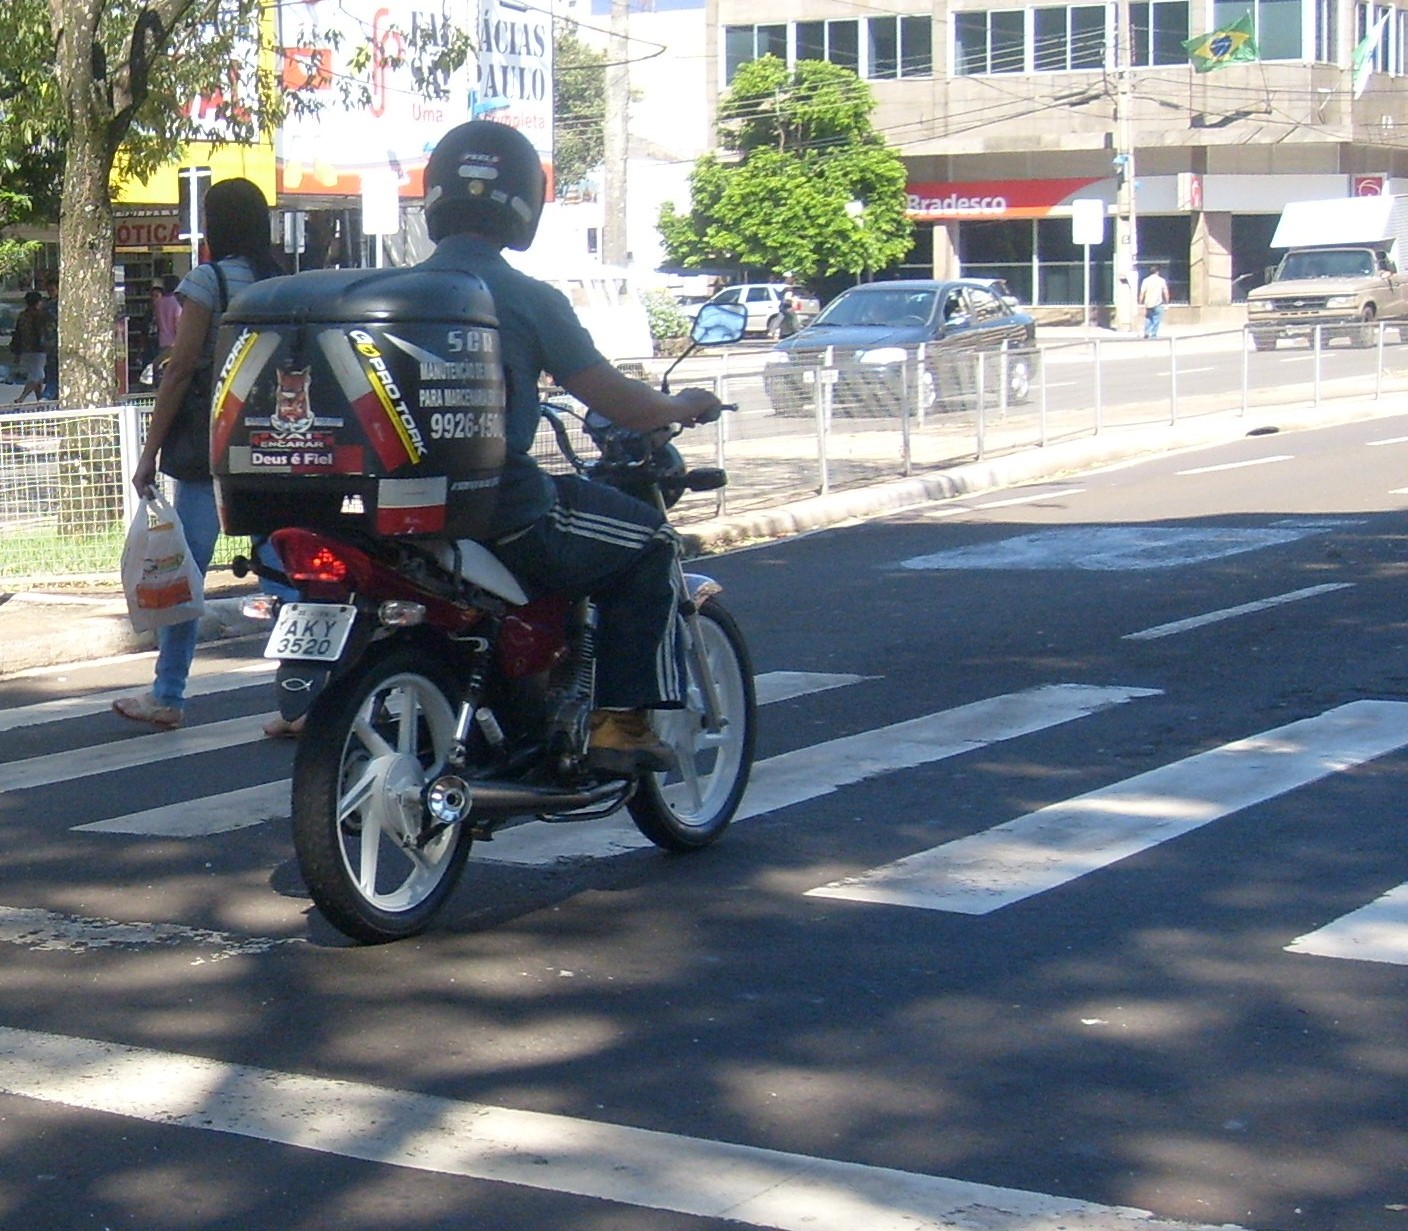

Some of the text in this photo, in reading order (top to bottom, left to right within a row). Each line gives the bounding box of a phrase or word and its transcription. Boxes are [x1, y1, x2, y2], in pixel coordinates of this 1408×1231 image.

[412, 103, 444, 123] Uma
[906, 193, 1006, 215] Bradesco
[117, 221, 180, 244] ÓTICA
[369, 357, 429, 456] PRO TORK
[419, 389, 443, 408] PARA
[252, 452, 333, 465] Deus é Fiel
[284, 620, 336, 637] AKY
[277, 638, 331, 655] 3520
